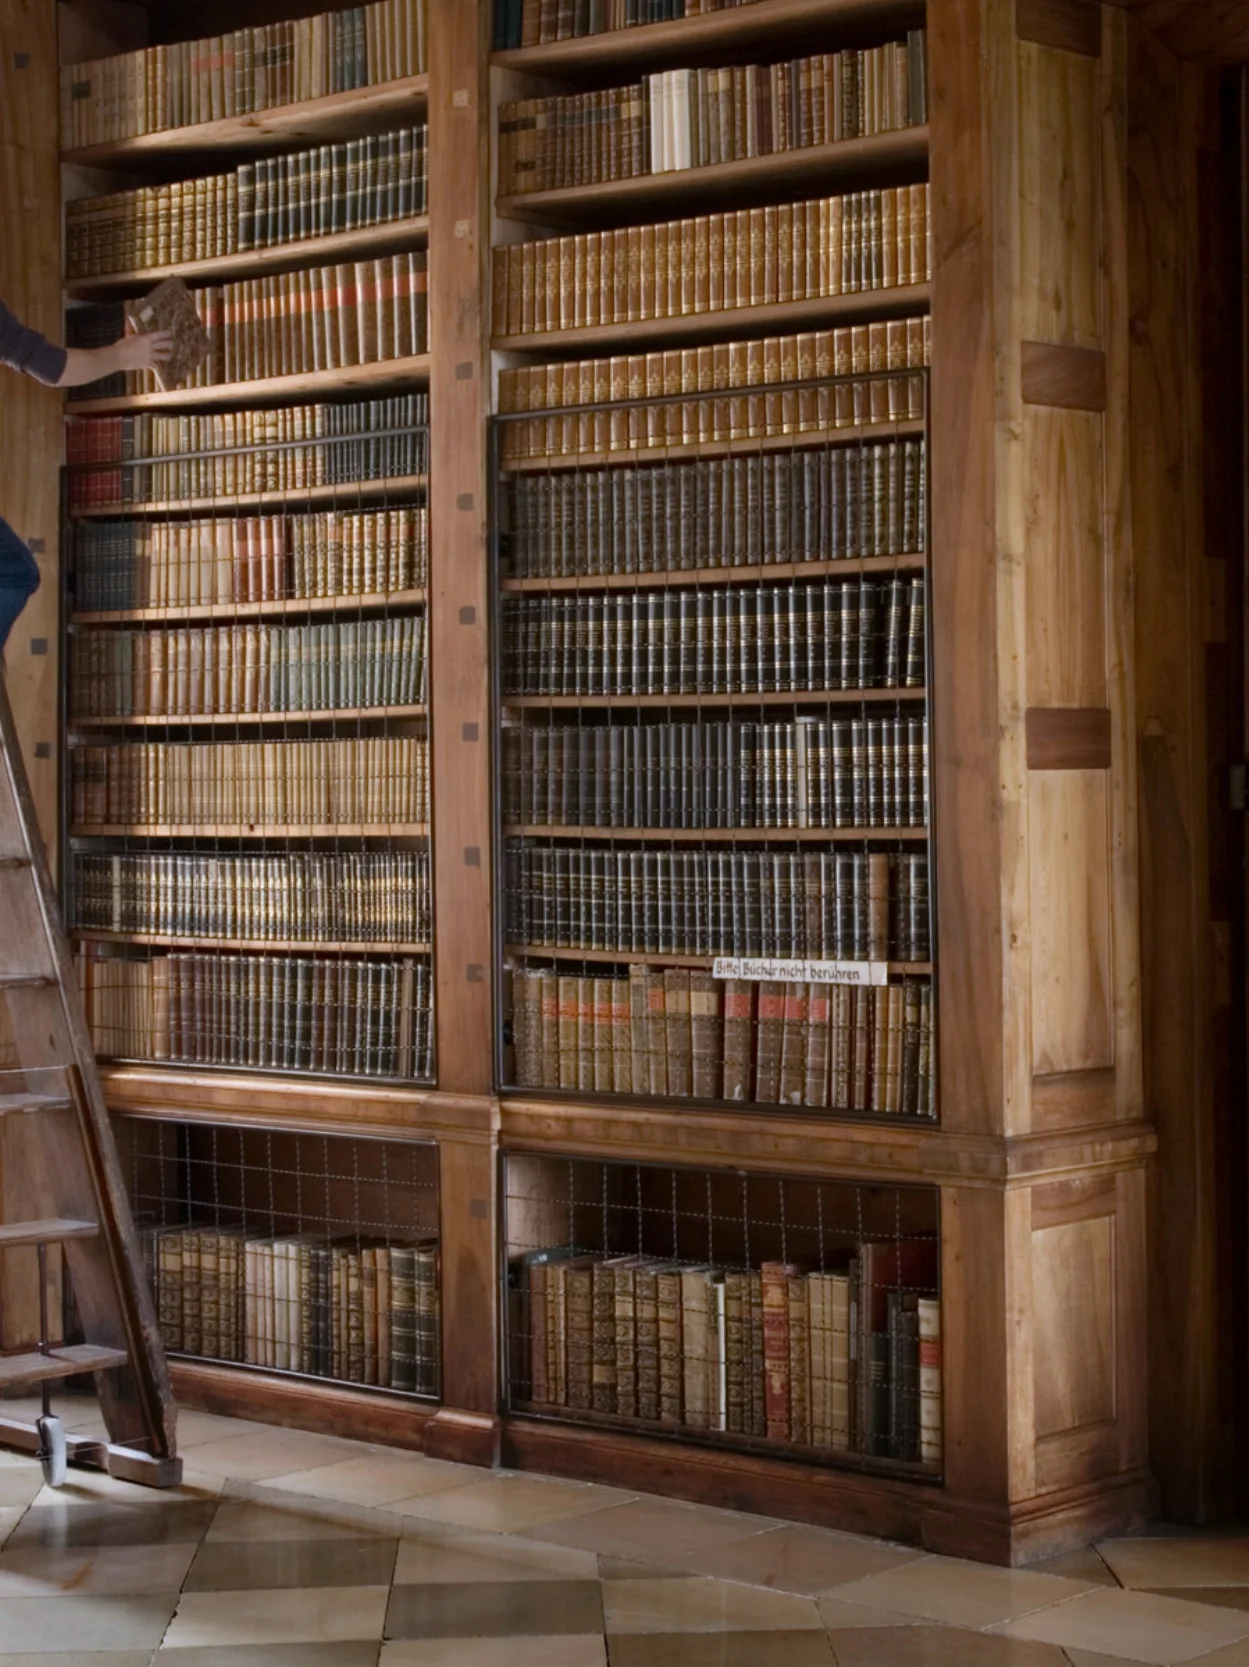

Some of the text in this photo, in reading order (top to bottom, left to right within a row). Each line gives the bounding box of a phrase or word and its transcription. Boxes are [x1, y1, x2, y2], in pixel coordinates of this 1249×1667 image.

[743, 961, 777, 977] Bücher
[780, 964, 807, 978] nicht
[810, 964, 860, 980] berühren
